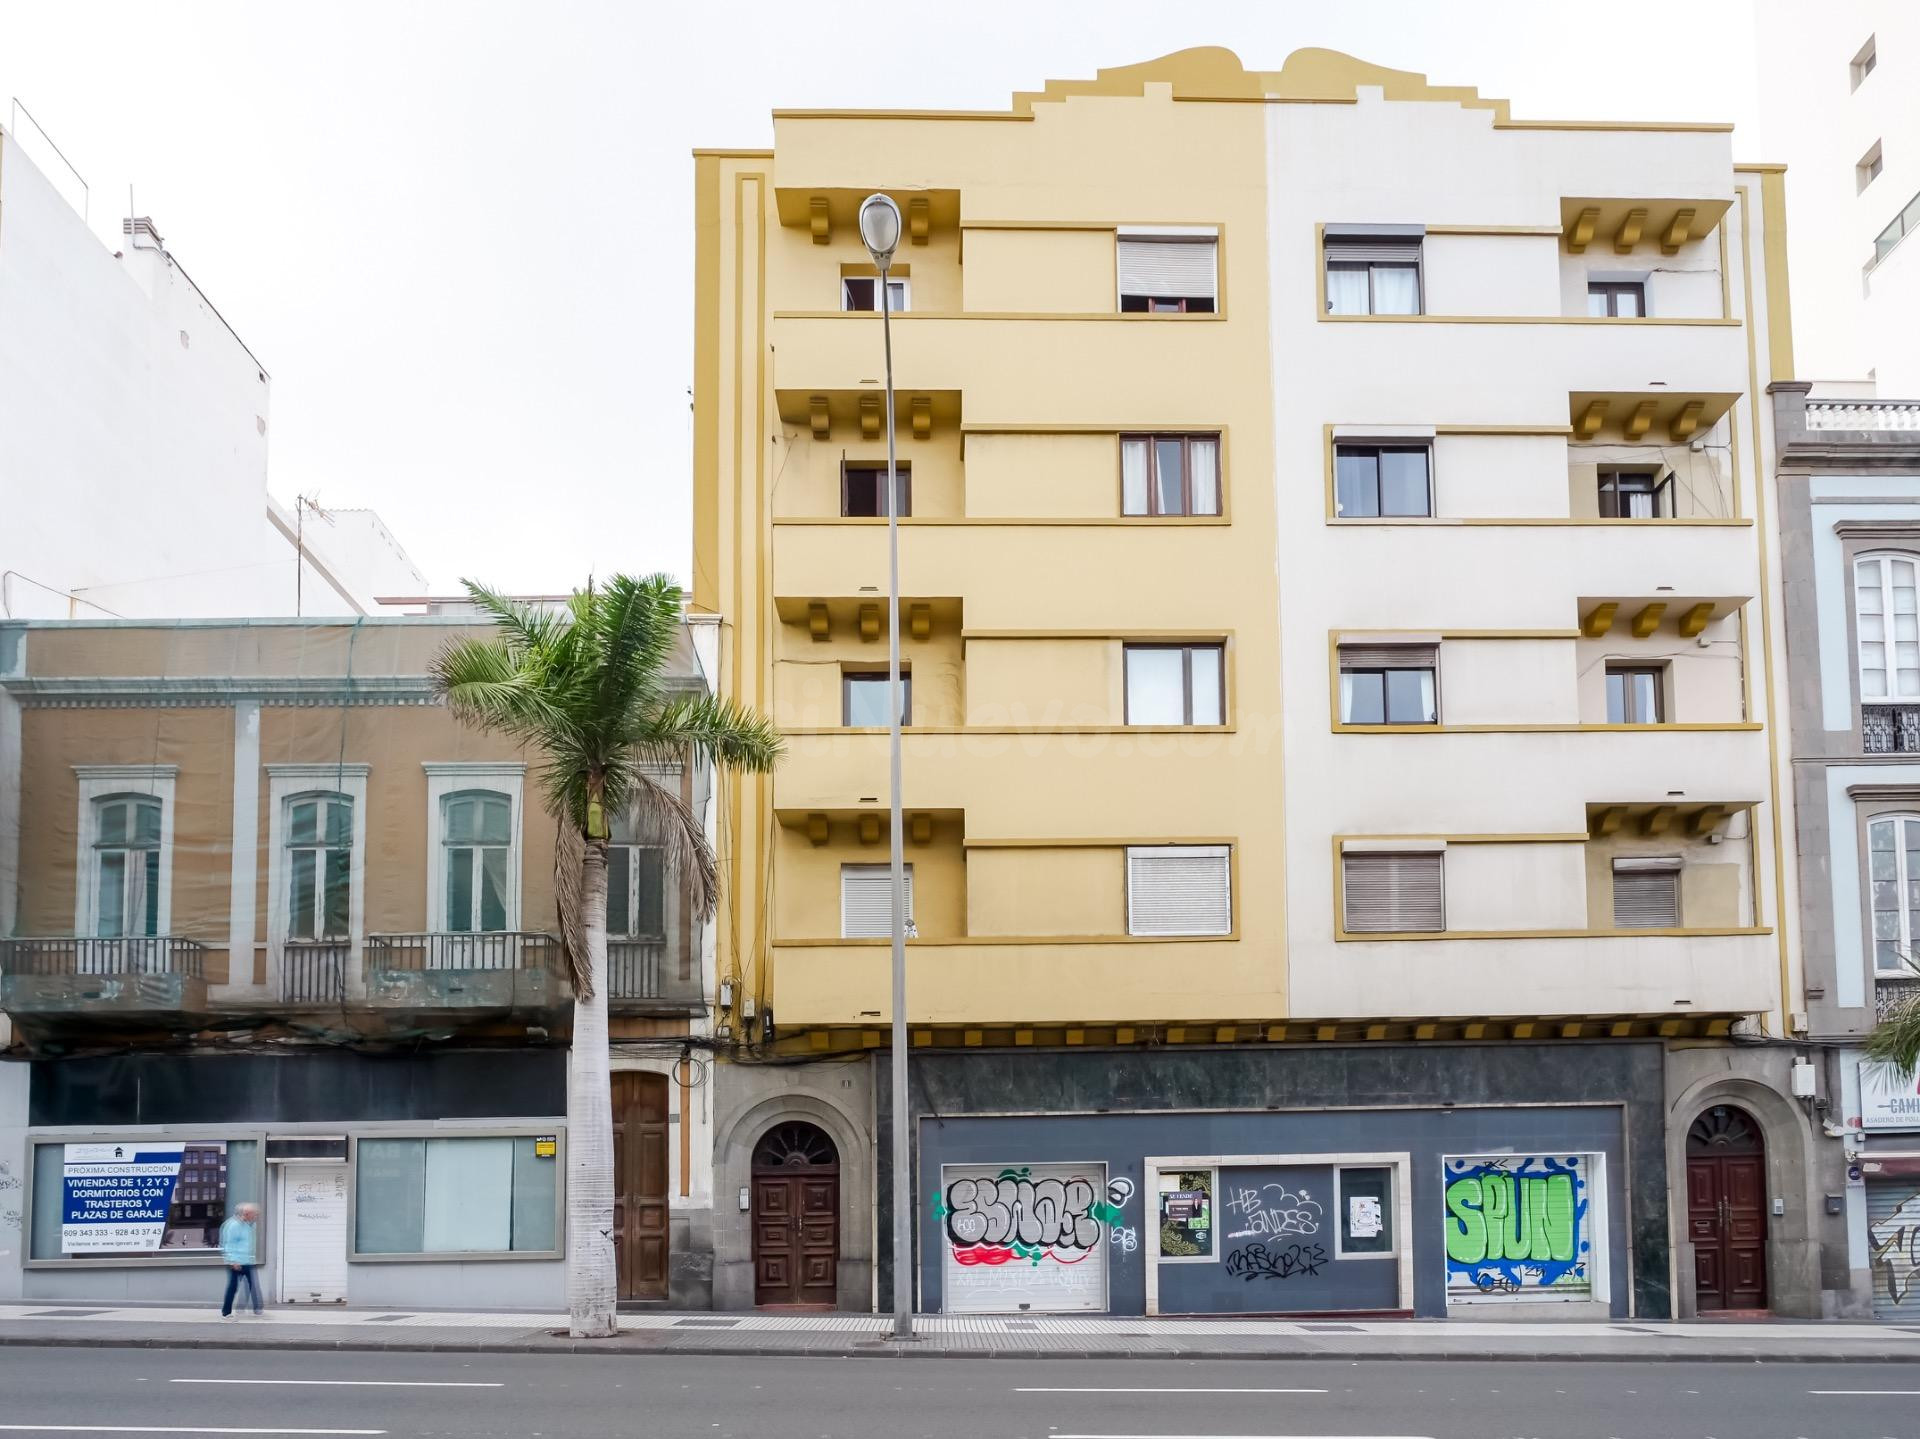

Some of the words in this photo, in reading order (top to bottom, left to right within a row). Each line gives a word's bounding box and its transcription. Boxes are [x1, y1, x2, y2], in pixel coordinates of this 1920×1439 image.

[68, 1166, 105, 1174] PRÓXIMA
[107, 1165, 174, 1174] CONSTRUCCIÓN
[67, 1178, 118, 1188] VIVIENDAS
[120, 1178, 134, 1187] DE
[137, 1178, 144, 1188] 1,
[146, 1178, 153, 1187] 2
[154, 1178, 161, 1187] Y
[163, 1178, 170, 1187] 3
[72, 1189, 140, 1198] DORMITORIOS
[142, 1188, 164, 1197] CON
[85, 1200, 142, 1209] TRASTEROS
[144, 1199, 152, 1208] Y
[71, 1211, 108, 1220] PLAZAS
[110, 1210, 124, 1219] DE
[125, 1209, 164, 1218] GARAJE
[63, 1229, 78, 1237] 609
[115, 1228, 129, 1236] 928
[130, 1228, 140, 1236] 43
[141, 1228, 150, 1236] 37
